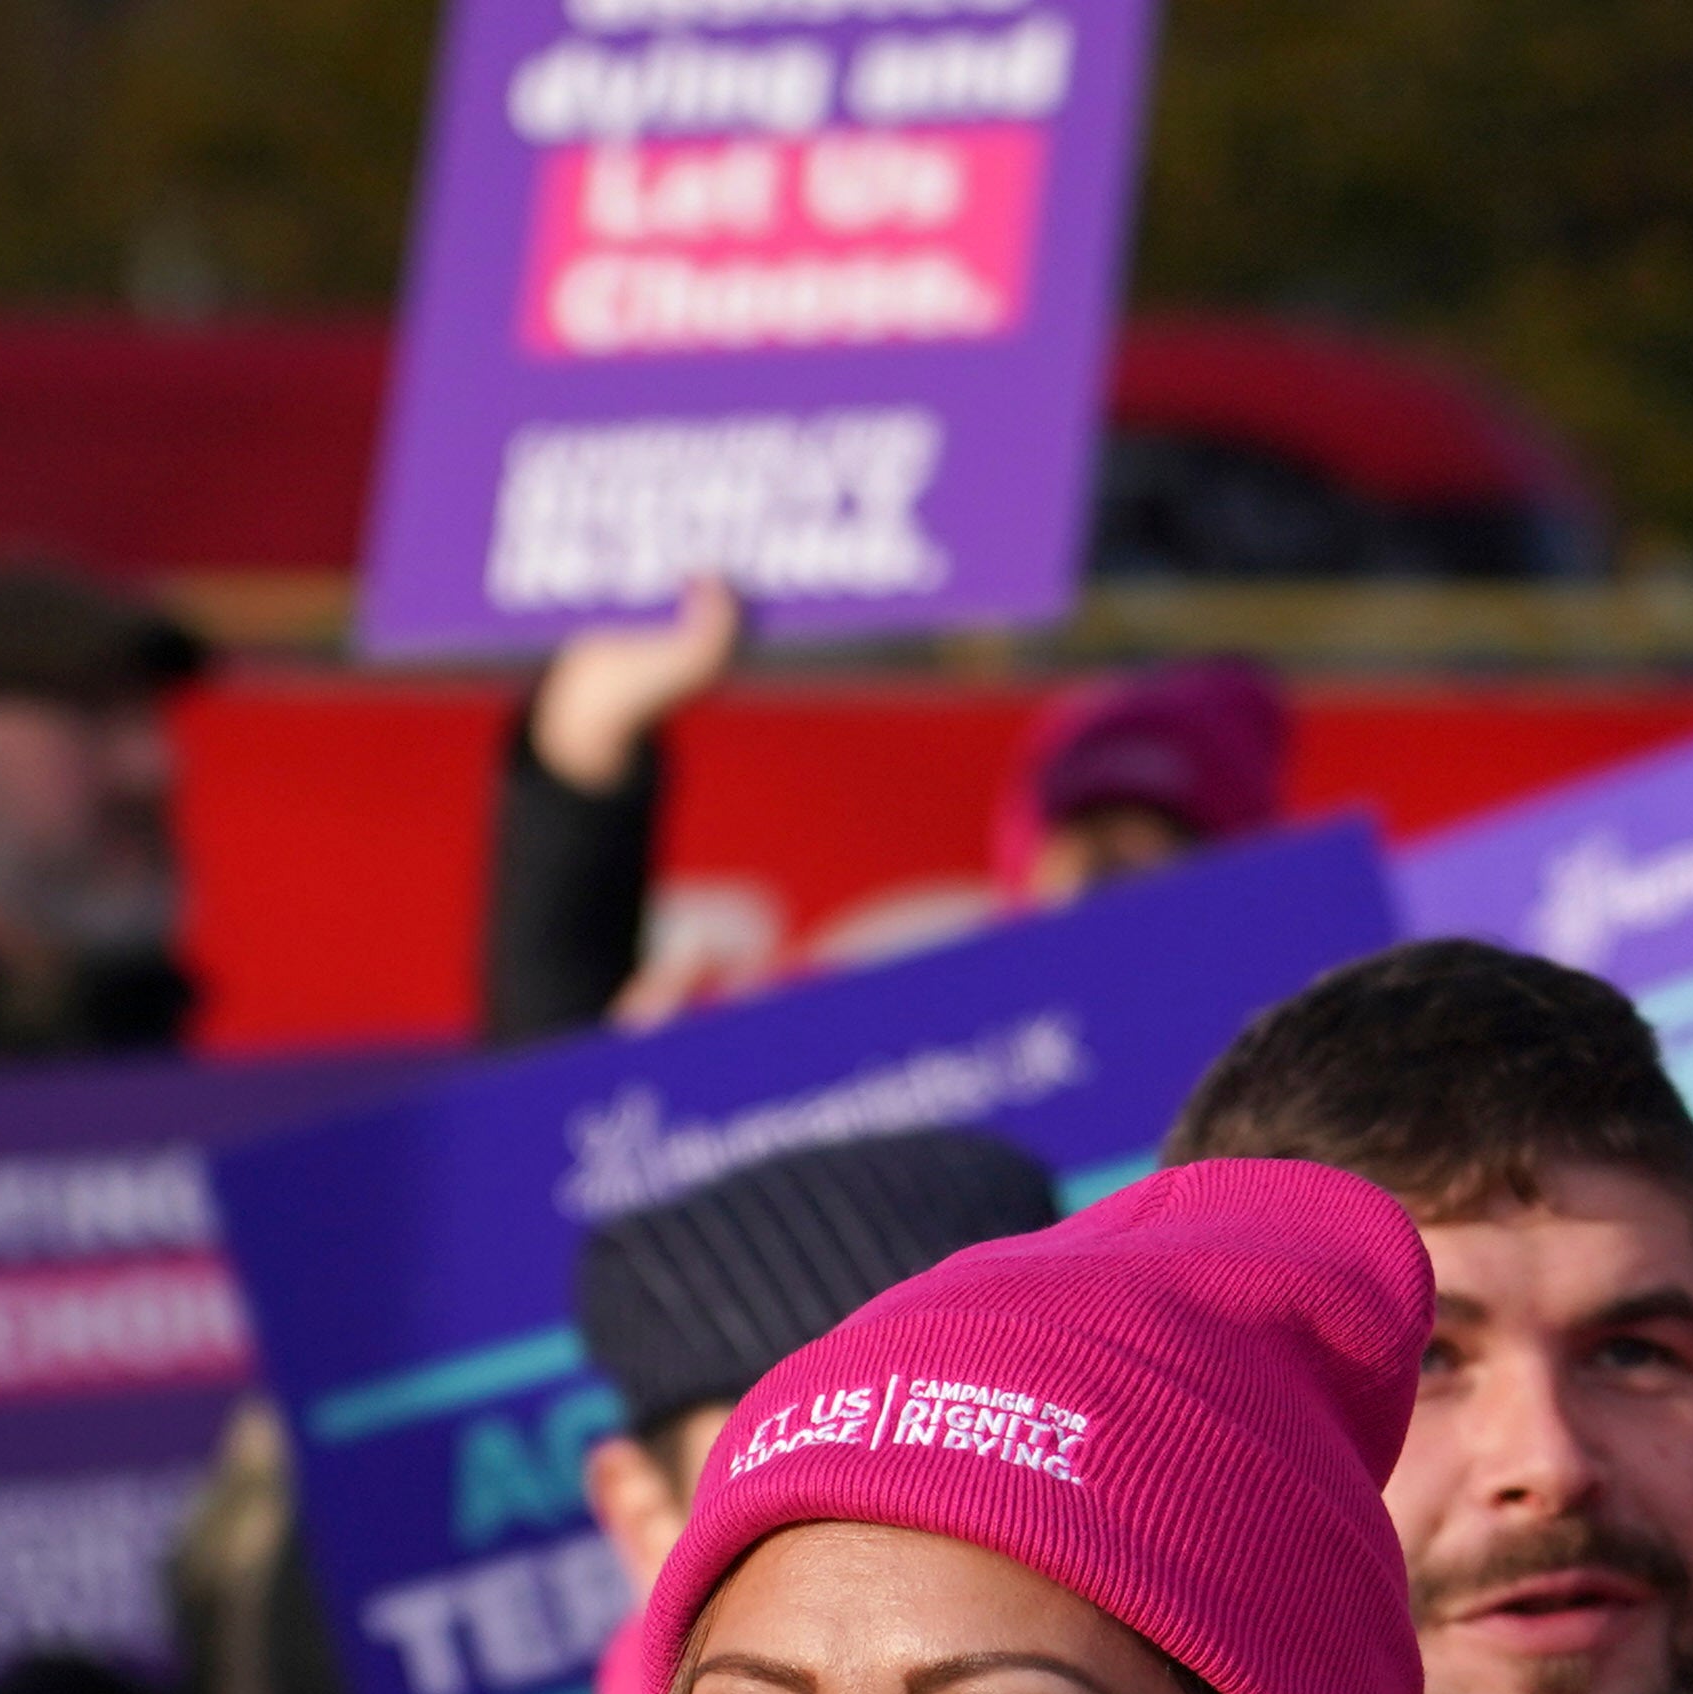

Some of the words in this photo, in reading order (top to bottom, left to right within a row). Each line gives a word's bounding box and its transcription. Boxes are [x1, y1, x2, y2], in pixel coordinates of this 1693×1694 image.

[810, 1387, 874, 1424] US
[900, 1399, 1084, 1455] DIGNITY
[908, 1378, 1035, 1417] CAMPAIGN
[1038, 1401, 1088, 1433] FOR
[893, 1422, 937, 1446] IN
[942, 1429, 1083, 1486] DYING.
